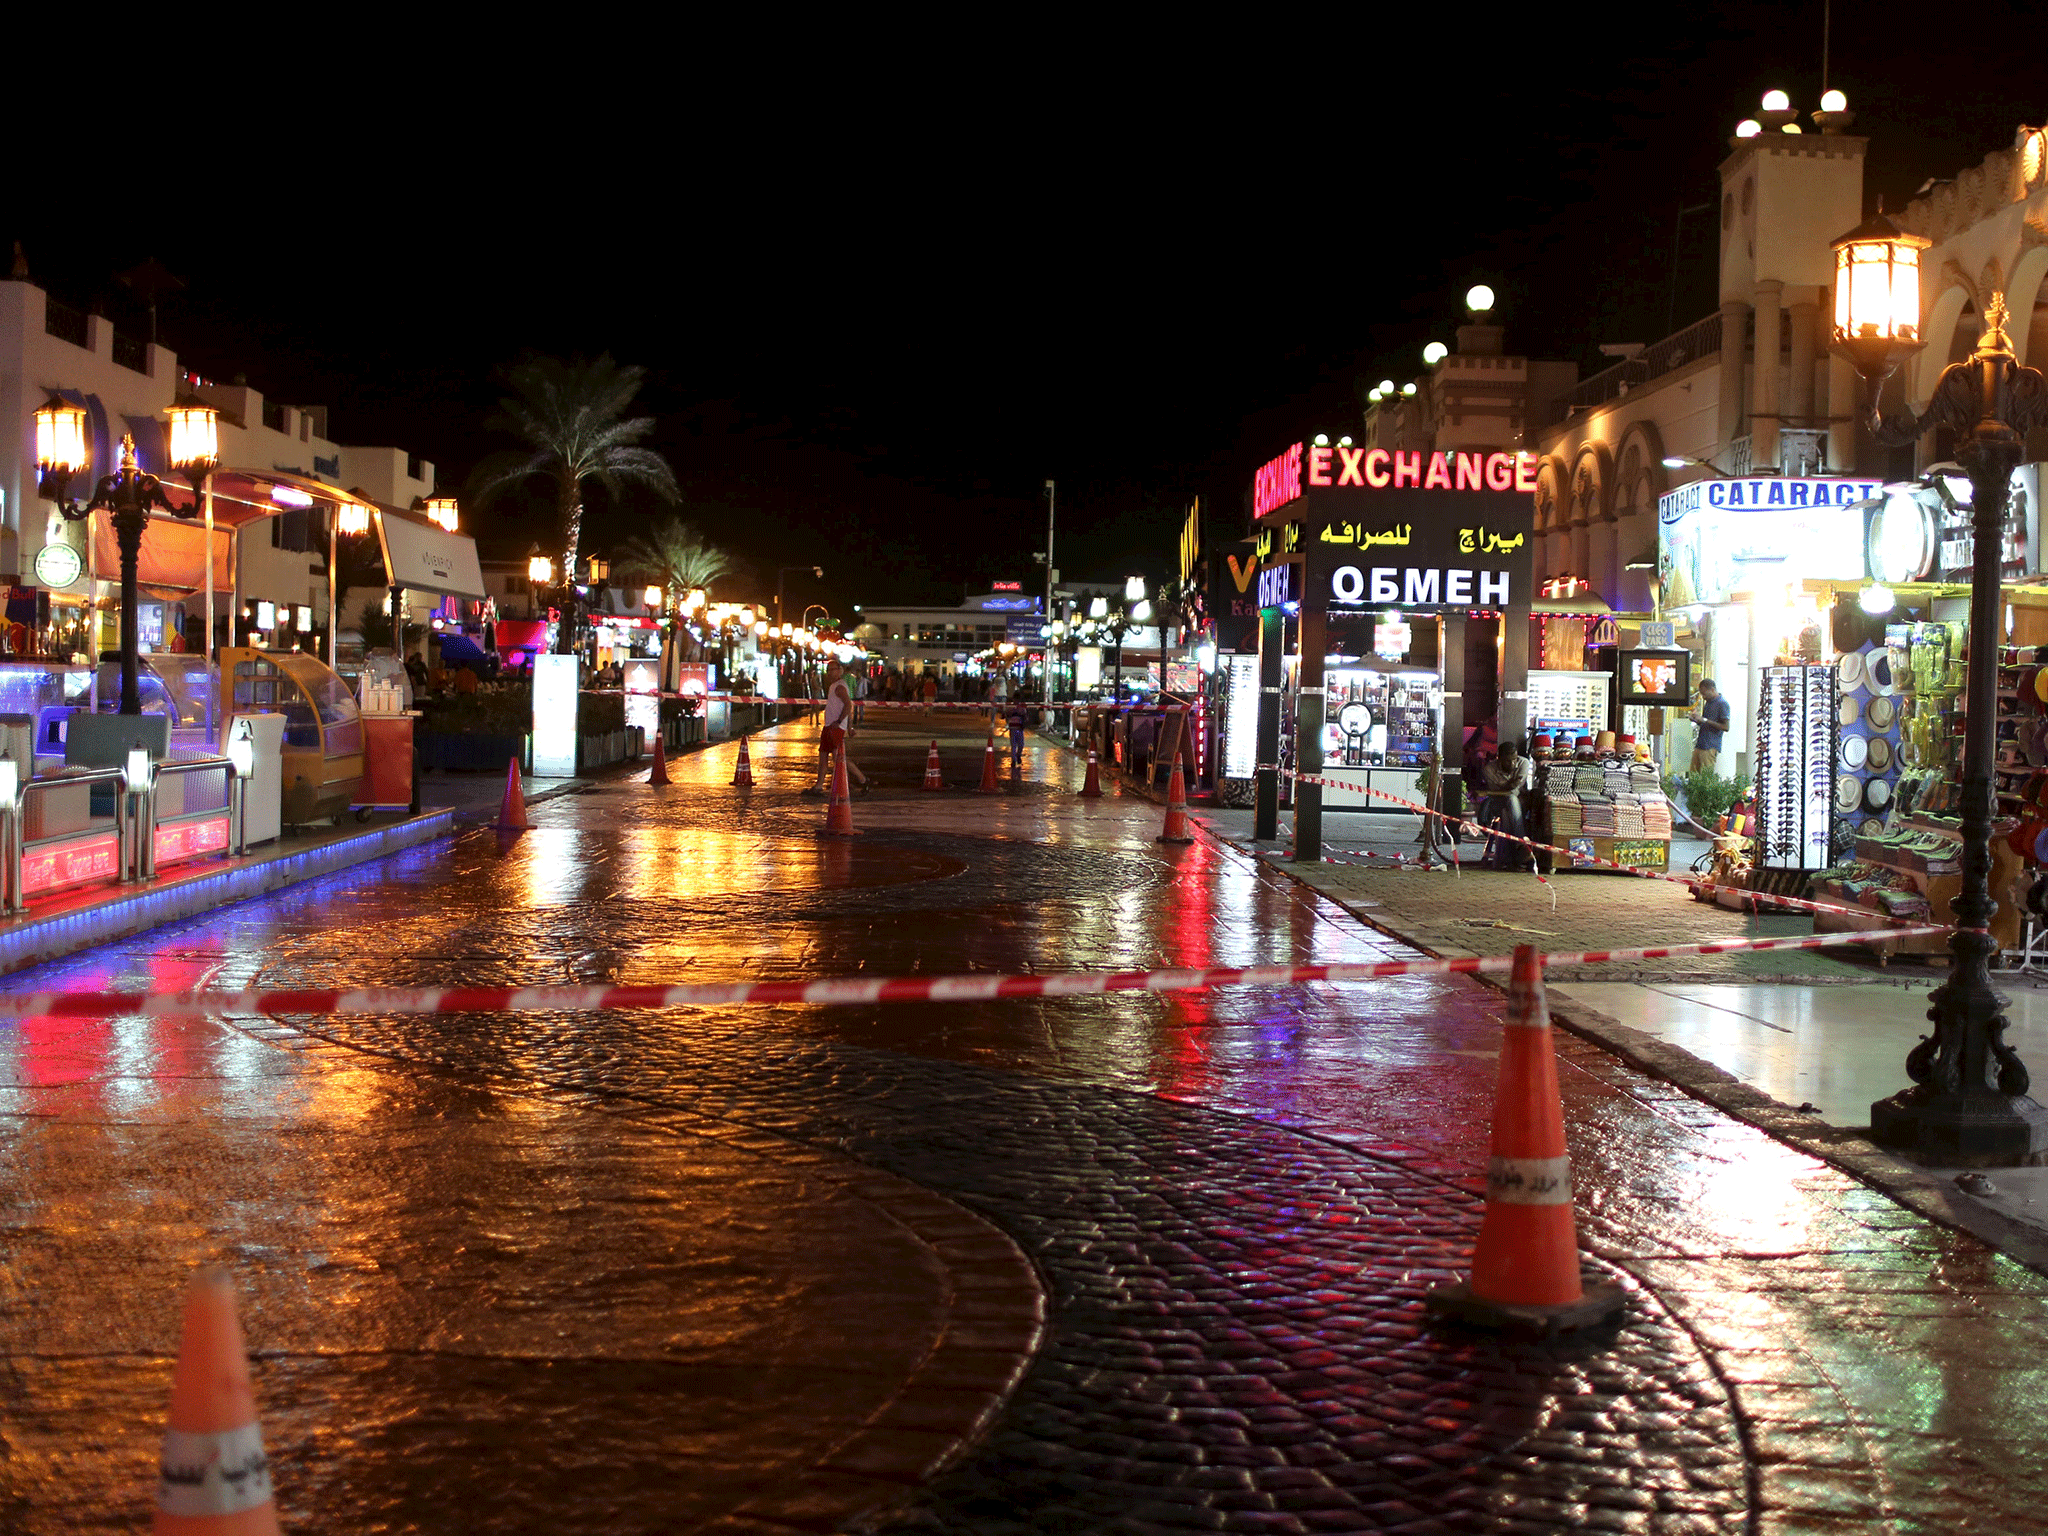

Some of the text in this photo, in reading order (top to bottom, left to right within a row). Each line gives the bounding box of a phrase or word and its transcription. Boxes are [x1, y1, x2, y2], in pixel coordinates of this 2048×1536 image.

[1254, 441, 1303, 519] EXCHANGE
[1309, 447, 1538, 492] EXCHANGE
[1661, 485, 1701, 520] CATARACT
[1708, 481, 1874, 506] CATARACT
[1258, 562, 1290, 609] ОБМЕН
[1332, 565, 1510, 605] ОБМЕН
[1645, 624, 1668, 637] CLEO
[1645, 636, 1669, 646] PARK
